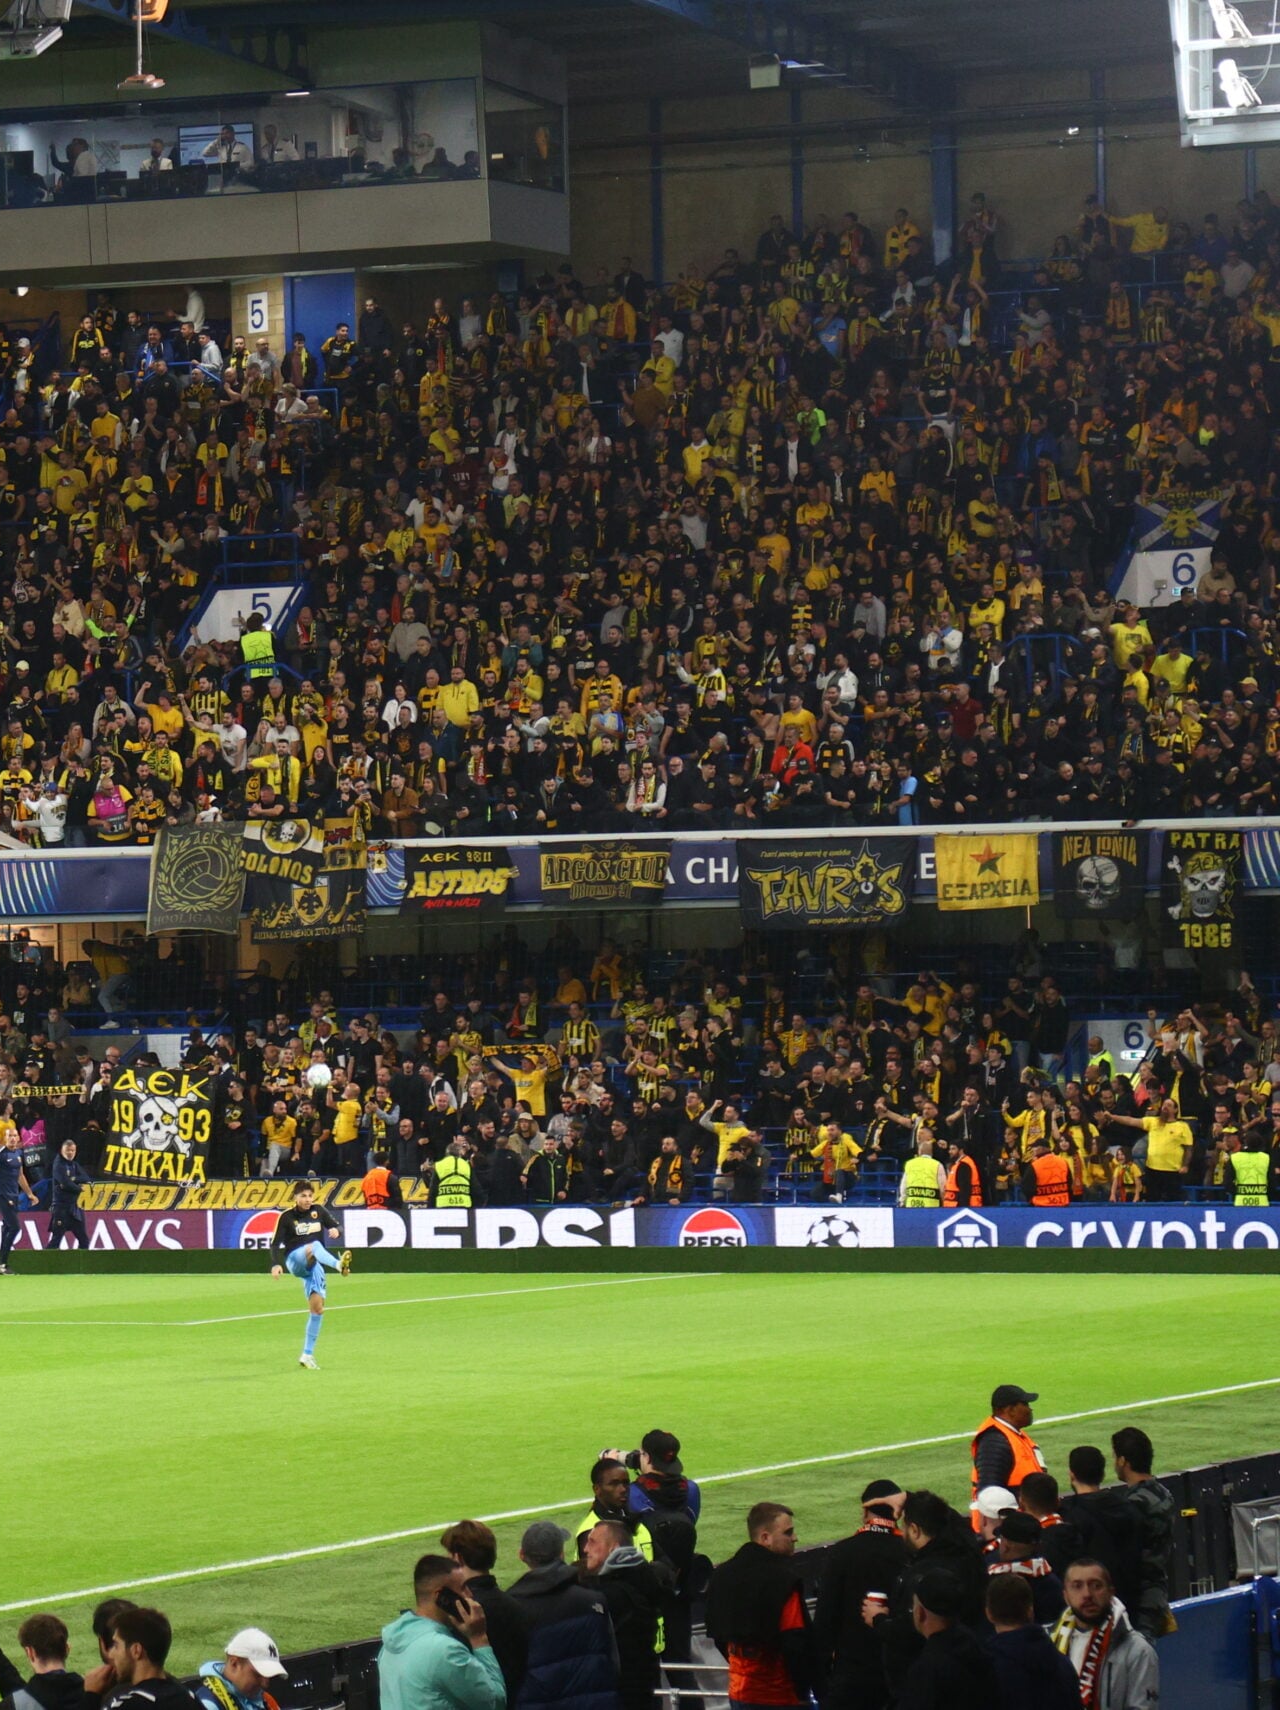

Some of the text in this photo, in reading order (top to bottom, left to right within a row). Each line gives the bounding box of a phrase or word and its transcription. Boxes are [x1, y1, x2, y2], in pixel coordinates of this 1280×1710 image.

[251, 299, 264, 329] 5
[1172, 552, 1196, 585] 6
[251, 592, 272, 623] 5
[1170, 832, 1240, 849] PATRA
[407, 867, 511, 899] ASTROS
[545, 856, 611, 885] ARGOS
[615, 855, 669, 884] CLUB
[1179, 922, 1232, 948] 1986
[1124, 1022, 1144, 1049] 6
[23, 1085, 74, 1096] TRIKALA
[111, 1098, 212, 1143] 19 93
[104, 1144, 206, 1183] TRIKALA
[343, 1207, 635, 1248] PEPSI
[1025, 1209, 1280, 1249] crypto
